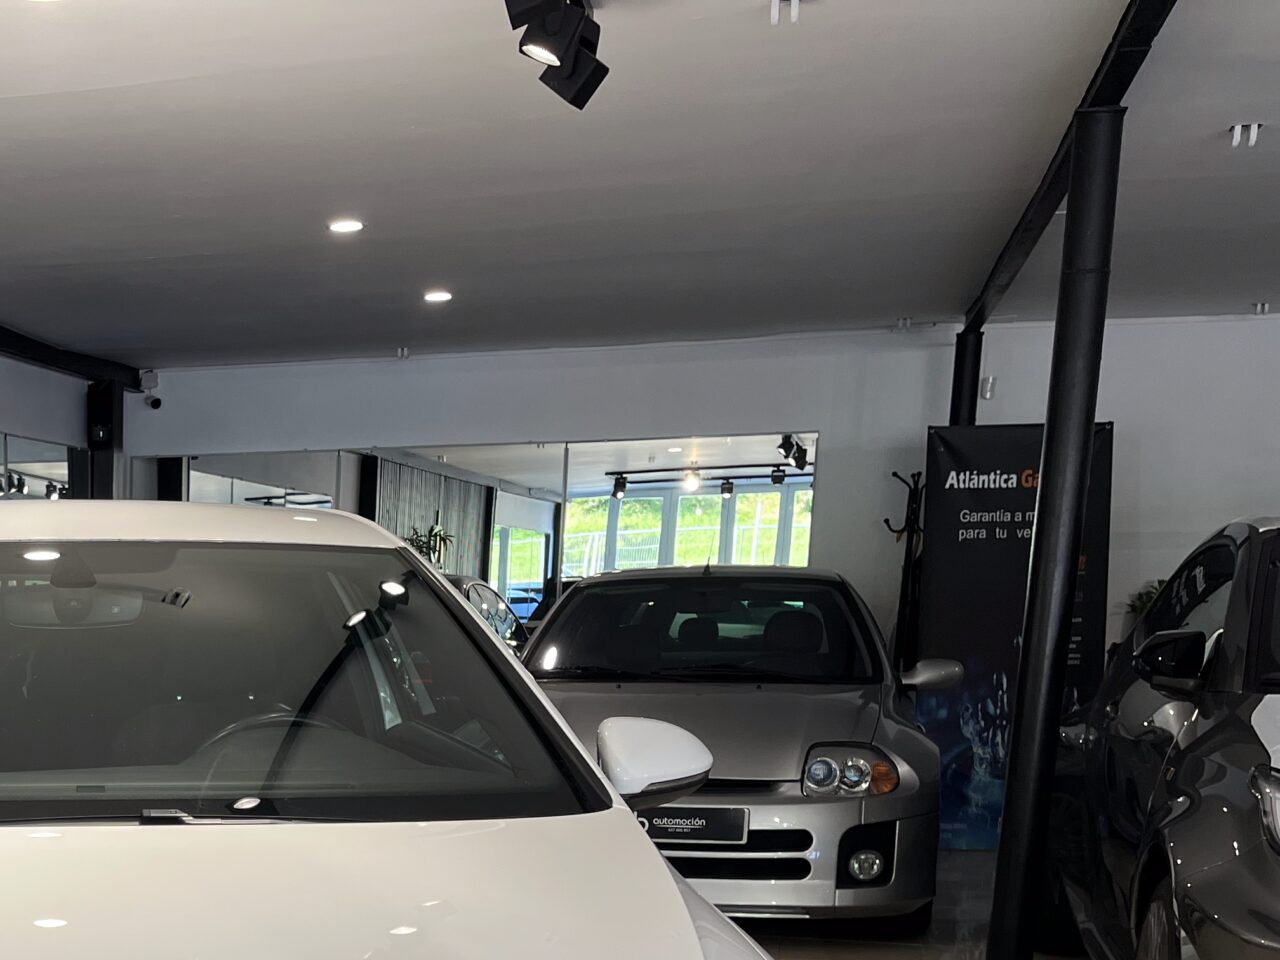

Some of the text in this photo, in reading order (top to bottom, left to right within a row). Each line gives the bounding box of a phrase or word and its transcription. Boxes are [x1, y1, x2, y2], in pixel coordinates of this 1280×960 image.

[944, 469, 1040, 489] Atlántica Ga
[959, 509, 1011, 522] Garantía
[1014, 511, 1022, 522] a
[958, 526, 1032, 542] para tu ve
[652, 817, 706, 827] automoción
